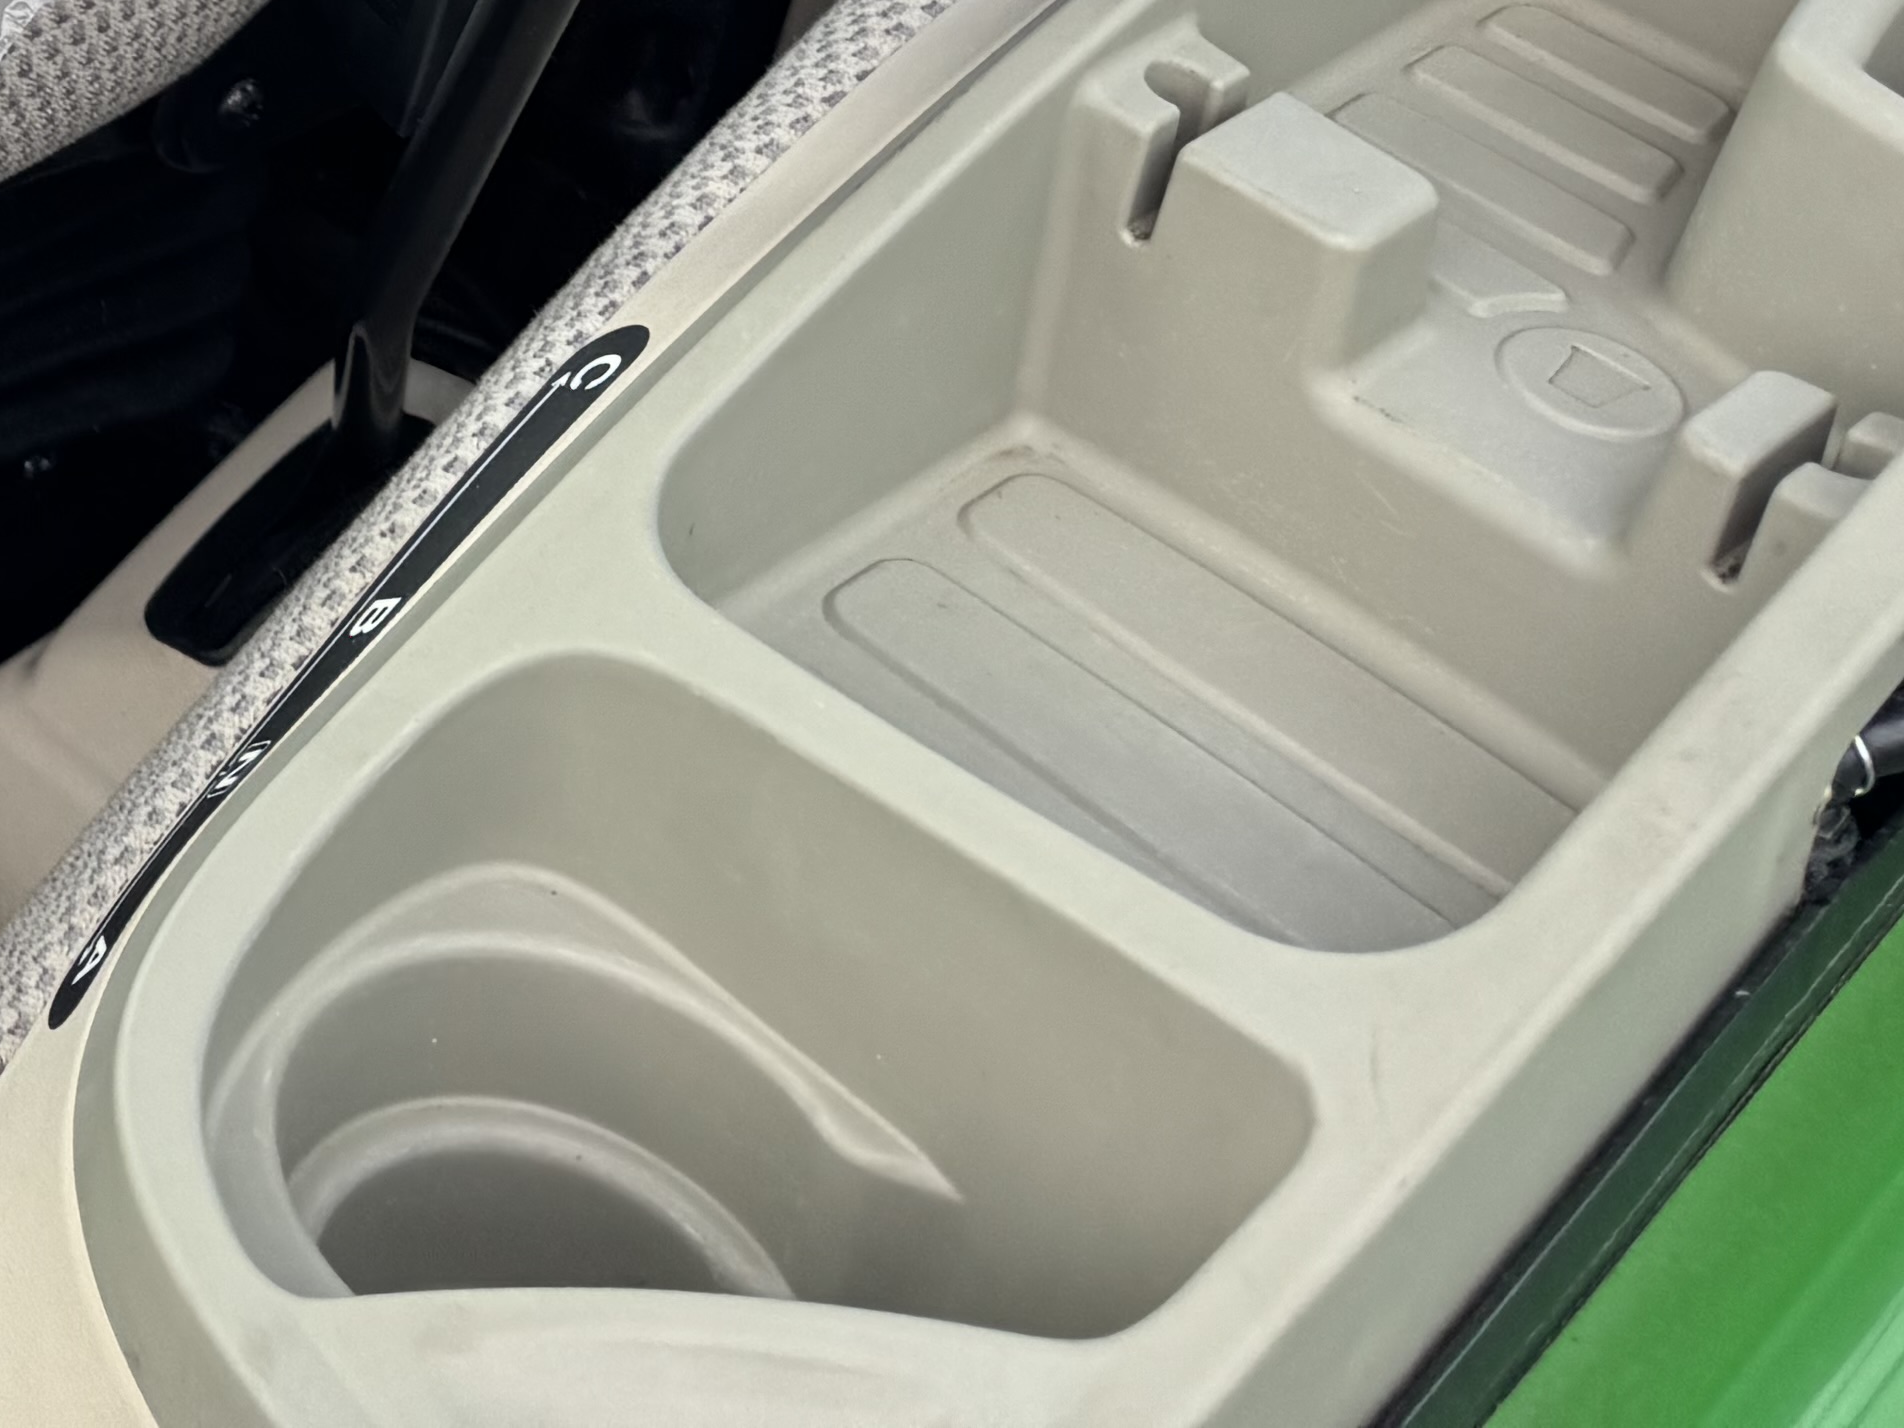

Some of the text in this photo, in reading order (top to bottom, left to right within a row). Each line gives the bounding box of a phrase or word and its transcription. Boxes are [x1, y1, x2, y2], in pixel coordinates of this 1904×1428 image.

[570, 354, 621, 392] C
[349, 596, 401, 638] B
[72, 934, 110, 984] A
